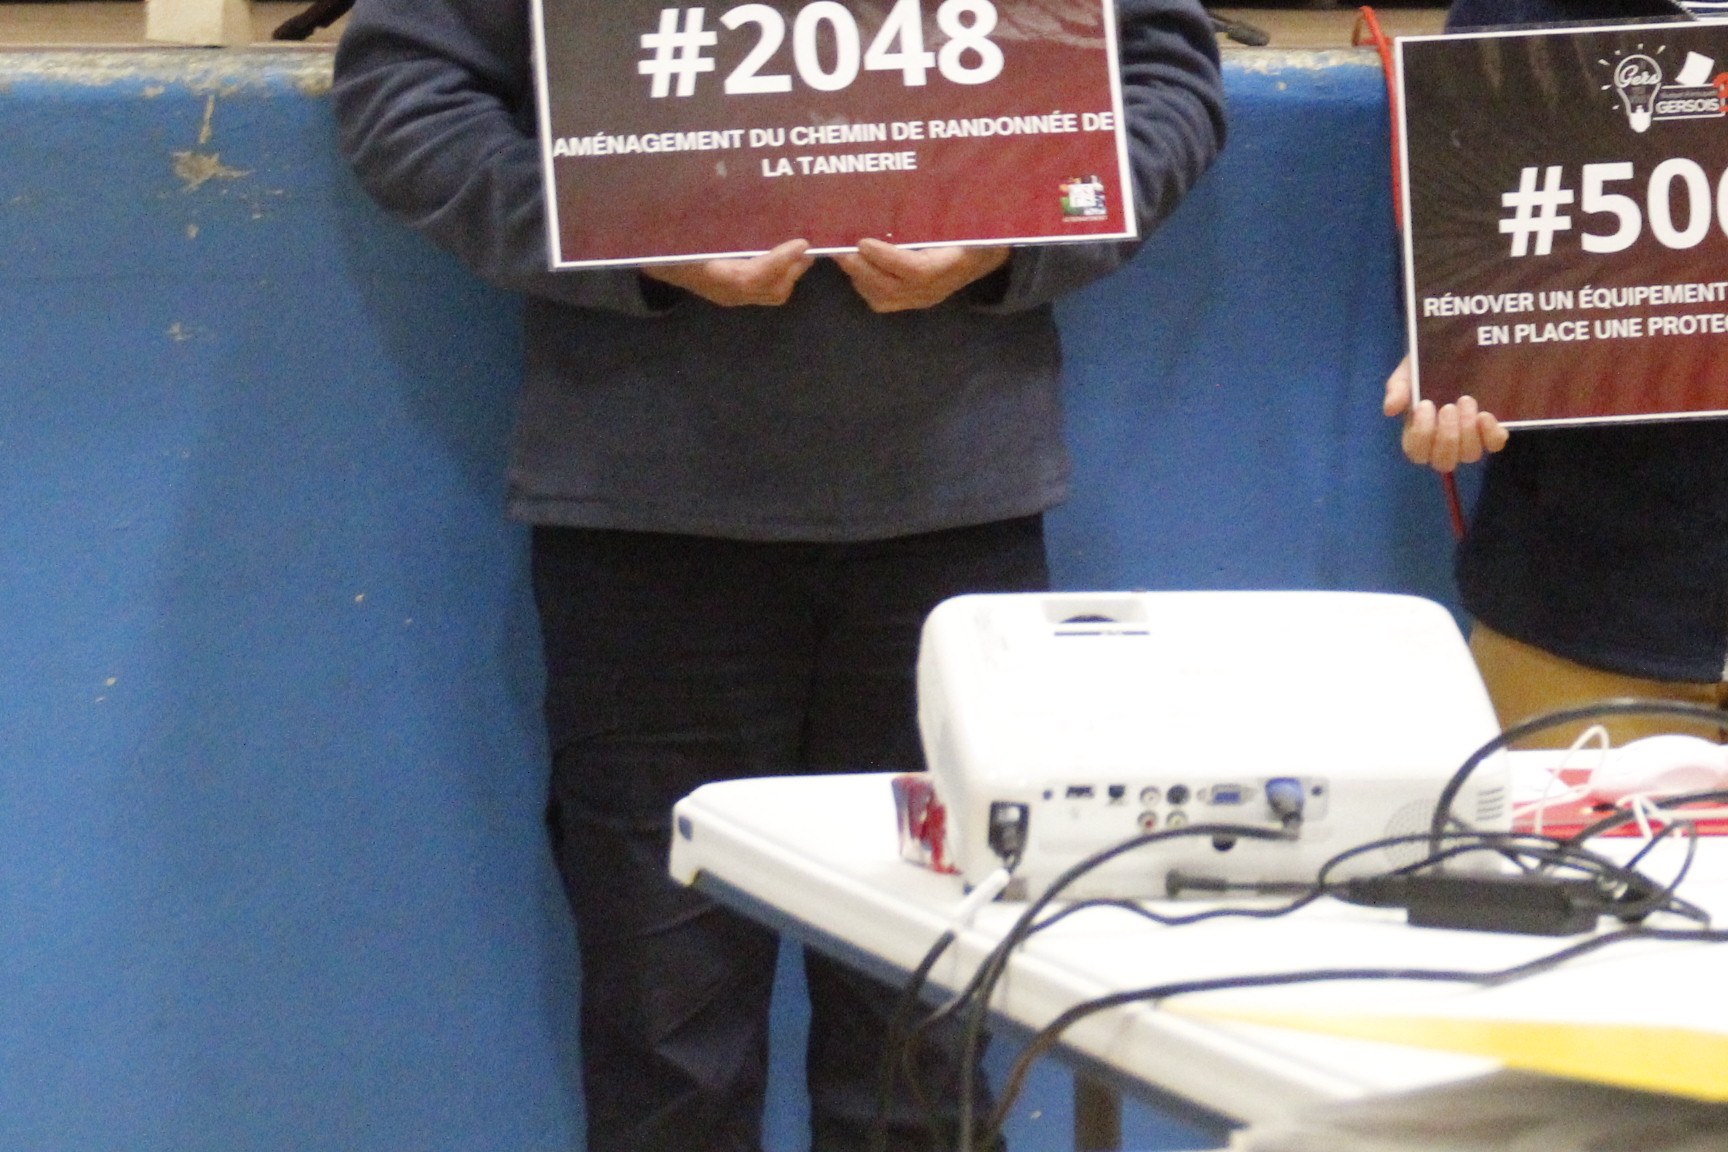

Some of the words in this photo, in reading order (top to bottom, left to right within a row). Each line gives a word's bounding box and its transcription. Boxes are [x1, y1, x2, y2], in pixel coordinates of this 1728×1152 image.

[1655, 98, 1720, 114] GERSOIS
[553, 129, 745, 157] AMÉNAGEMENT
[748, 128, 785, 148] DU
[790, 123, 887, 145] CHEMIN
[891, 121, 924, 141] DE
[928, 110, 1078, 138] RANDONNÉE
[1082, 111, 1115, 132] DE
[761, 158, 795, 177] LA
[796, 151, 917, 175] TANNERIE
[1423, 292, 1534, 317] RÉNOVER
[1539, 291, 1574, 311] UN
[1579, 282, 1728, 309] ÉQUIPEMENT
[1477, 325, 1509, 346] EN
[1514, 321, 1590, 344] PLACE
[1595, 318, 1643, 340] UNE
